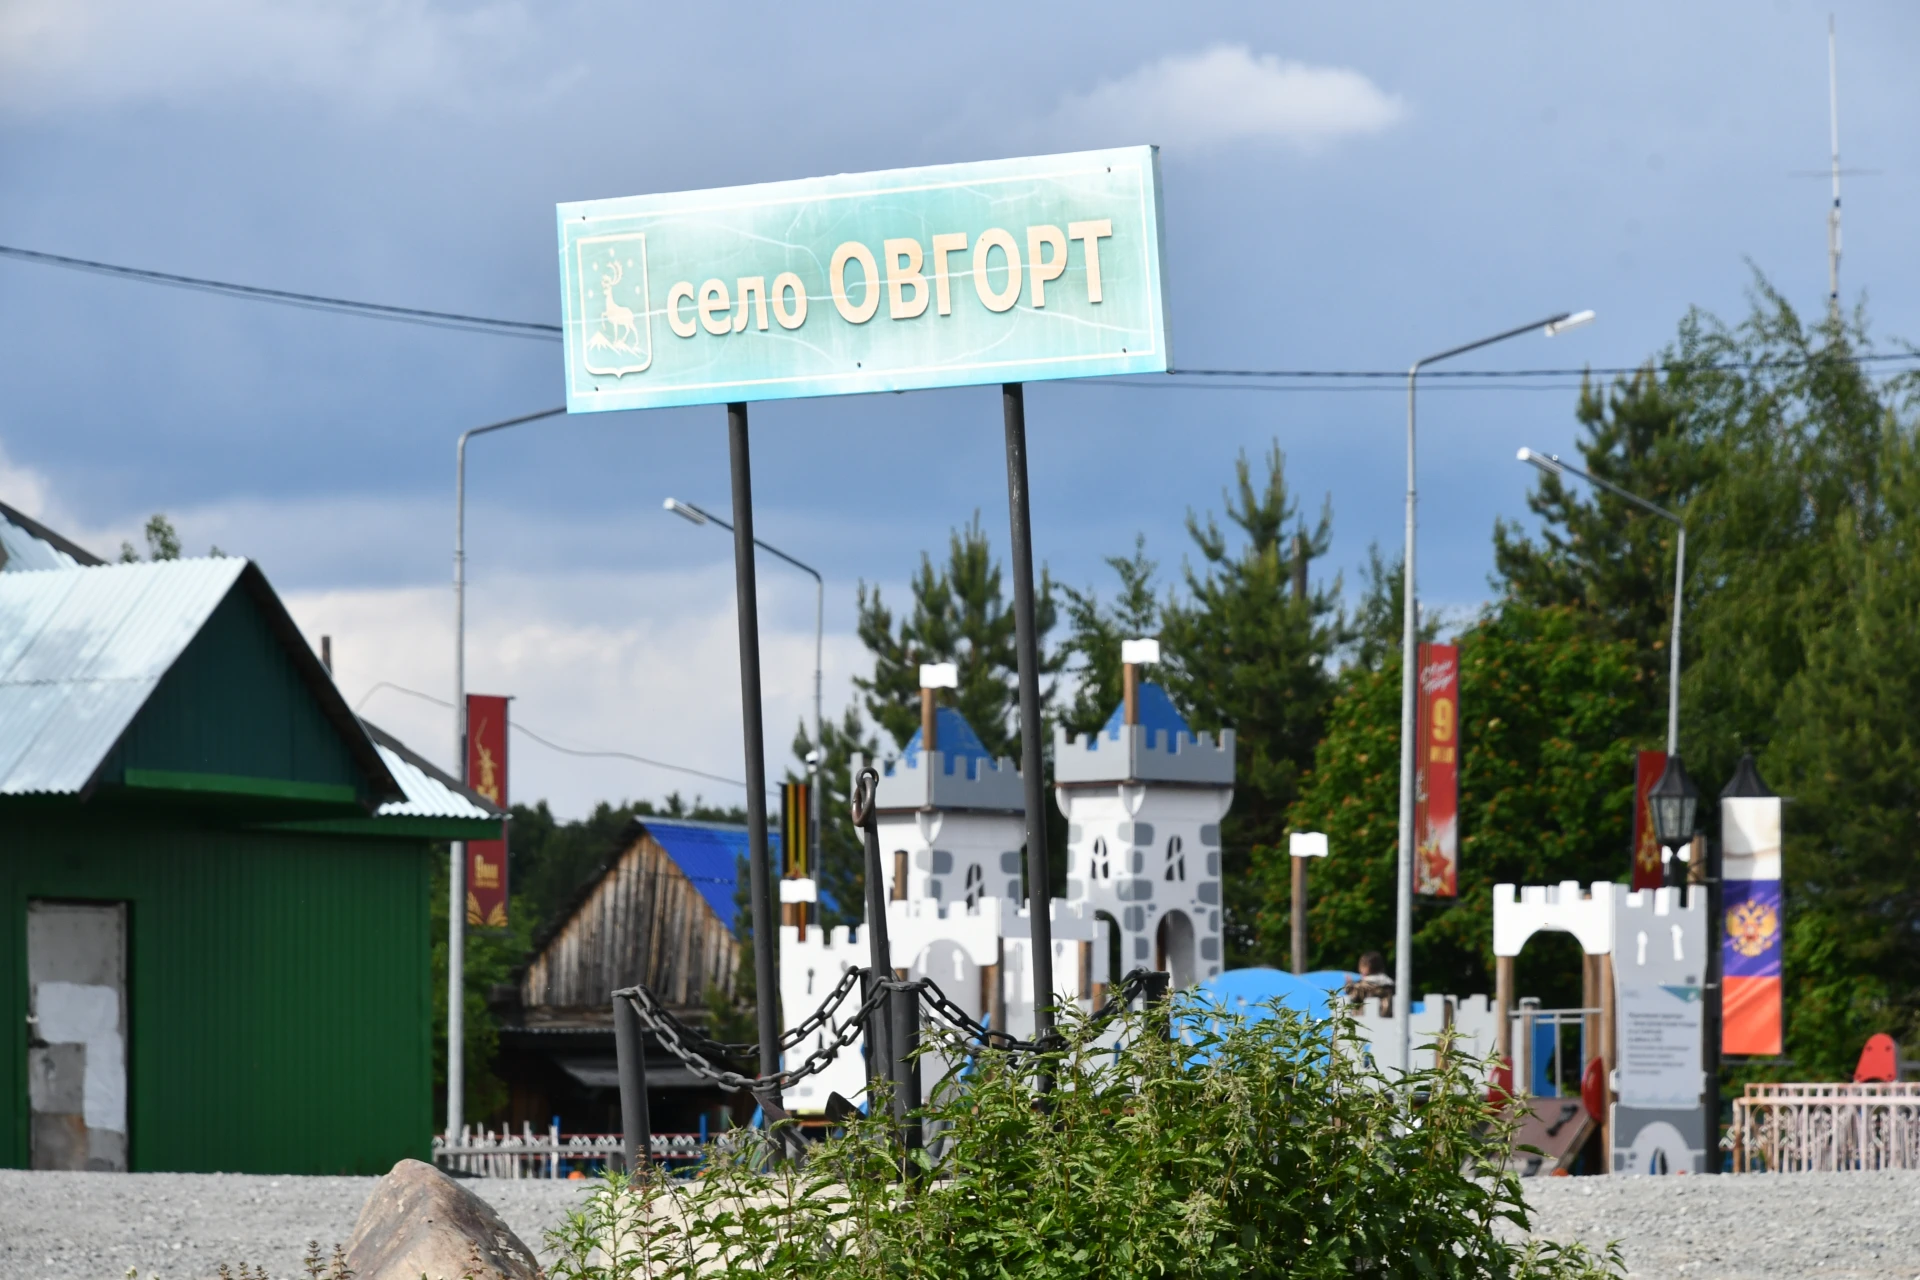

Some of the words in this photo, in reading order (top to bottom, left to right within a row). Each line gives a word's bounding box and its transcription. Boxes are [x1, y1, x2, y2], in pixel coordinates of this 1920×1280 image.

[667, 272, 808, 338] село
[829, 219, 1113, 325] ОВГОРТ
[1432, 698, 1454, 741] 9
